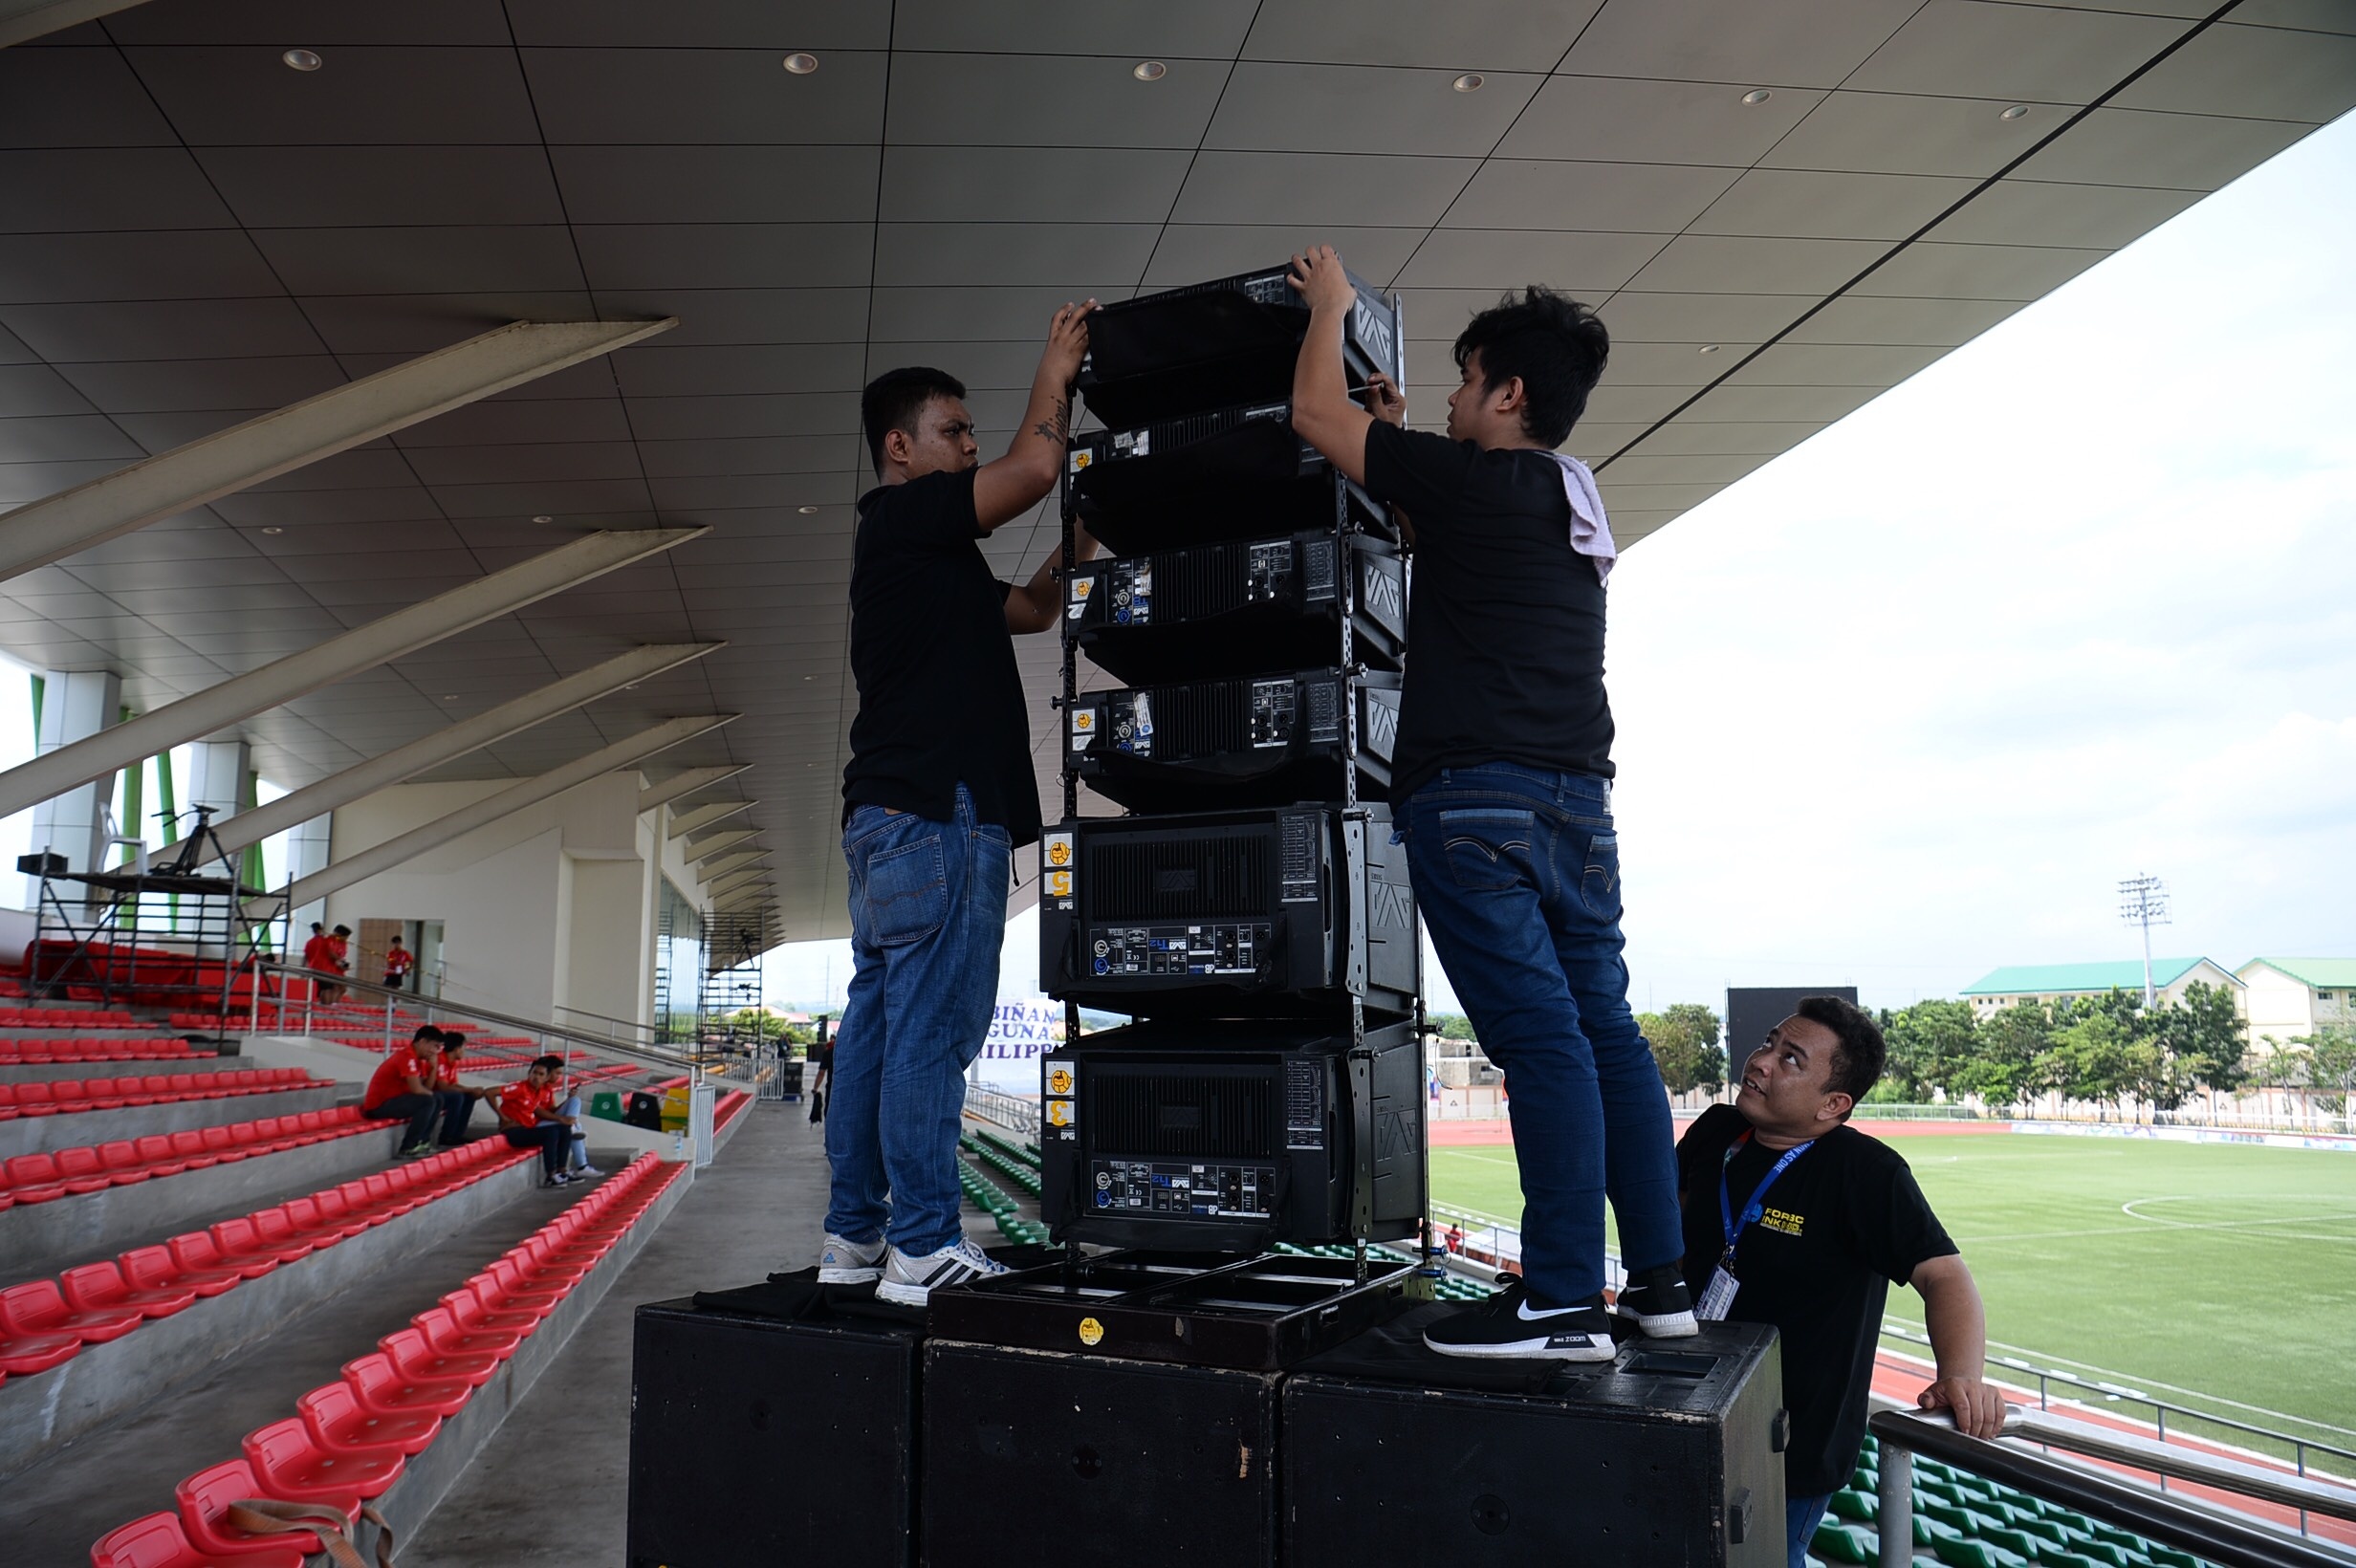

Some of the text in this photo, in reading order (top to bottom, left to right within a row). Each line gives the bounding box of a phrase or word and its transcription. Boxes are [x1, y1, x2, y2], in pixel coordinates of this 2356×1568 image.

[1052, 870, 1070, 897] 5
[979, 1043, 1053, 1059] ILIPP
[1051, 1100, 1068, 1127] 3
[1773, 1158, 1789, 1174] ONE
